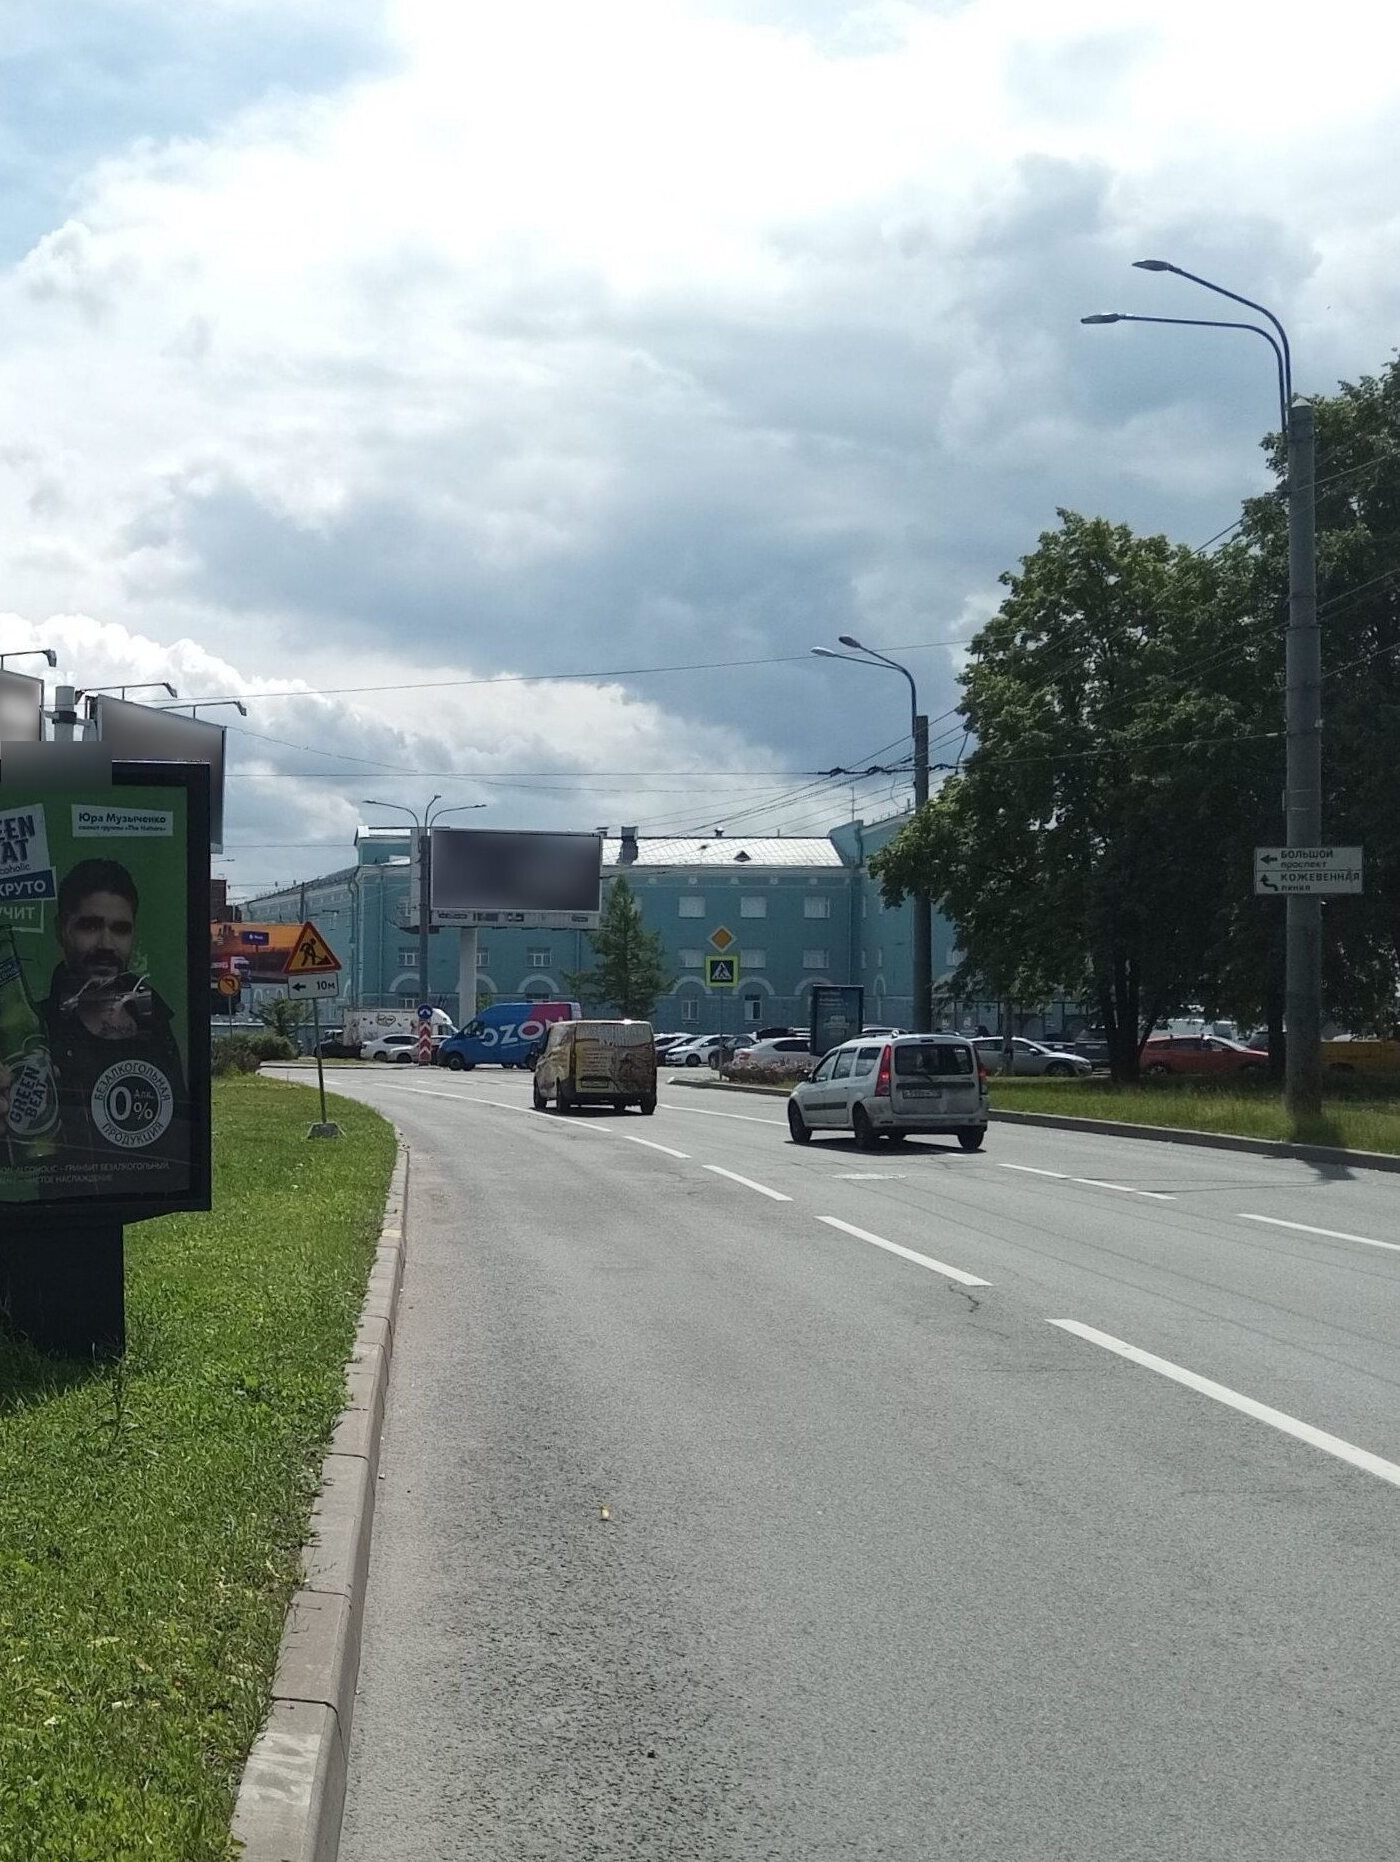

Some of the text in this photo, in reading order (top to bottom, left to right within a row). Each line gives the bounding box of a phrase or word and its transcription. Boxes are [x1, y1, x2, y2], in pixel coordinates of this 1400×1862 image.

[79, 812, 166, 825] Юра Музыченко
[1281, 849, 1334, 859] БОЛЬШОЙ
[1281, 861, 1327, 870] проспект
[1280, 871, 1360, 881] КОЖЕВЕННАЯ
[1281, 884, 1311, 892] линия
[94, 1062, 171, 1101] БЕЗАЛКОГОЛЬНАЯ
[10, 1066, 40, 1122] GREEN
[25, 1080, 46, 1117] BEAT
[101, 1121, 164, 1146] ПРОДУКЦИЯ
